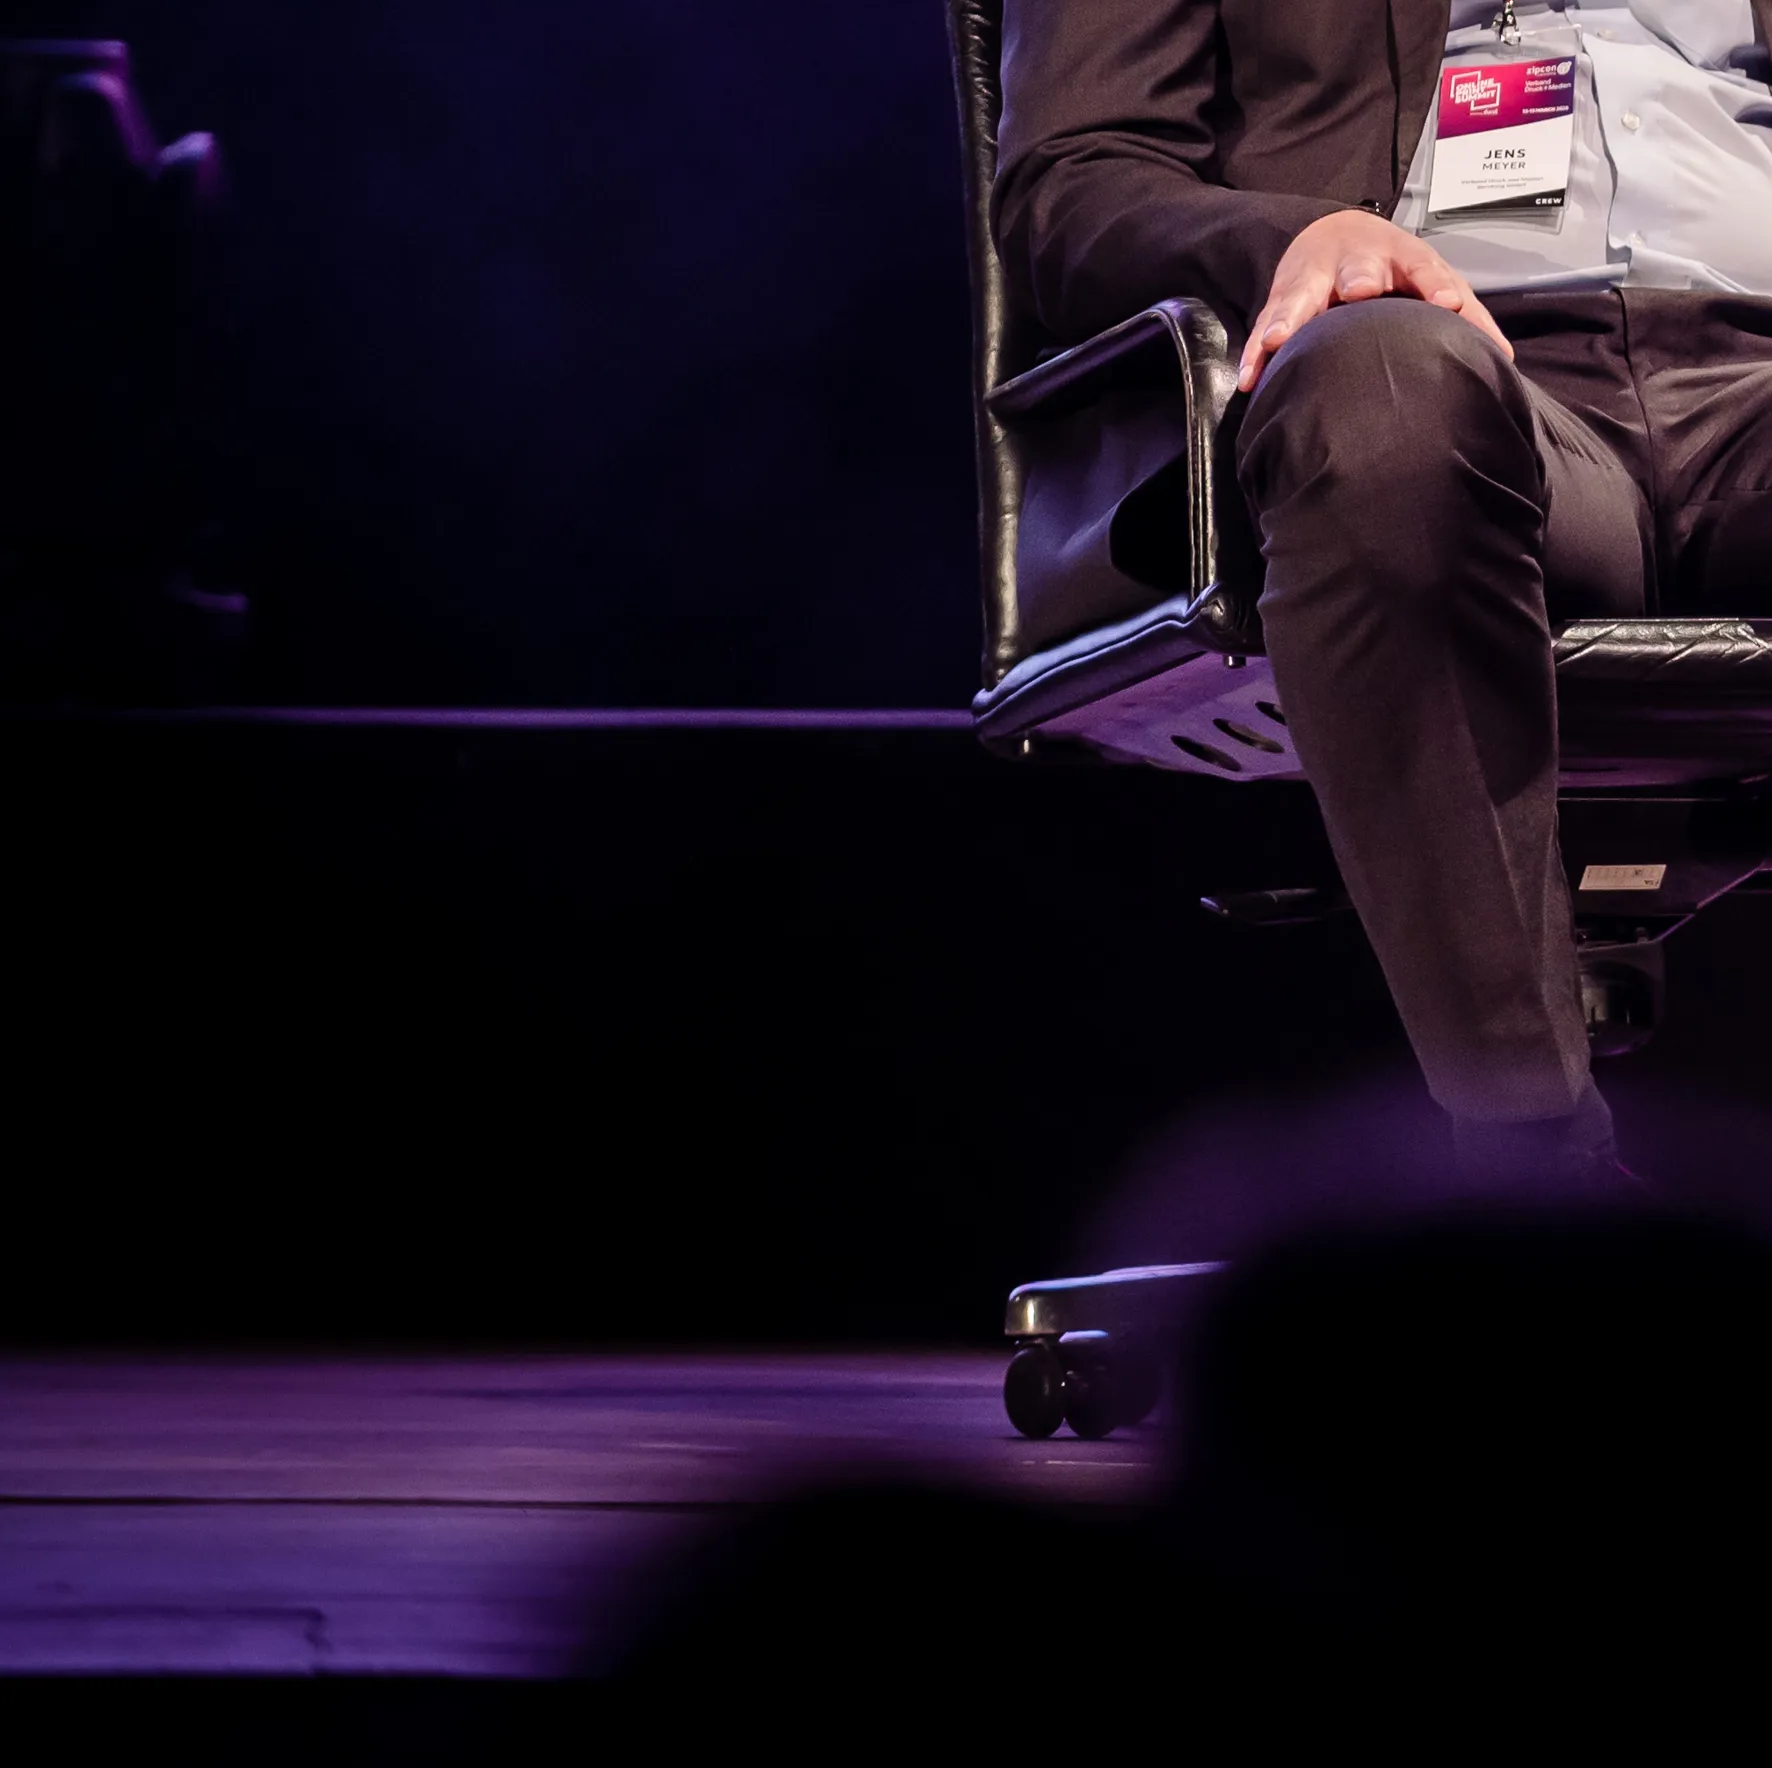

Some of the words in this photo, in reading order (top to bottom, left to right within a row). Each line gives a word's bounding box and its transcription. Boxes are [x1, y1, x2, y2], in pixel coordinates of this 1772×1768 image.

[1484, 148, 1526, 160] JENS
[1482, 161, 1526, 171] MEYER
[1535, 197, 1562, 206] CREW
